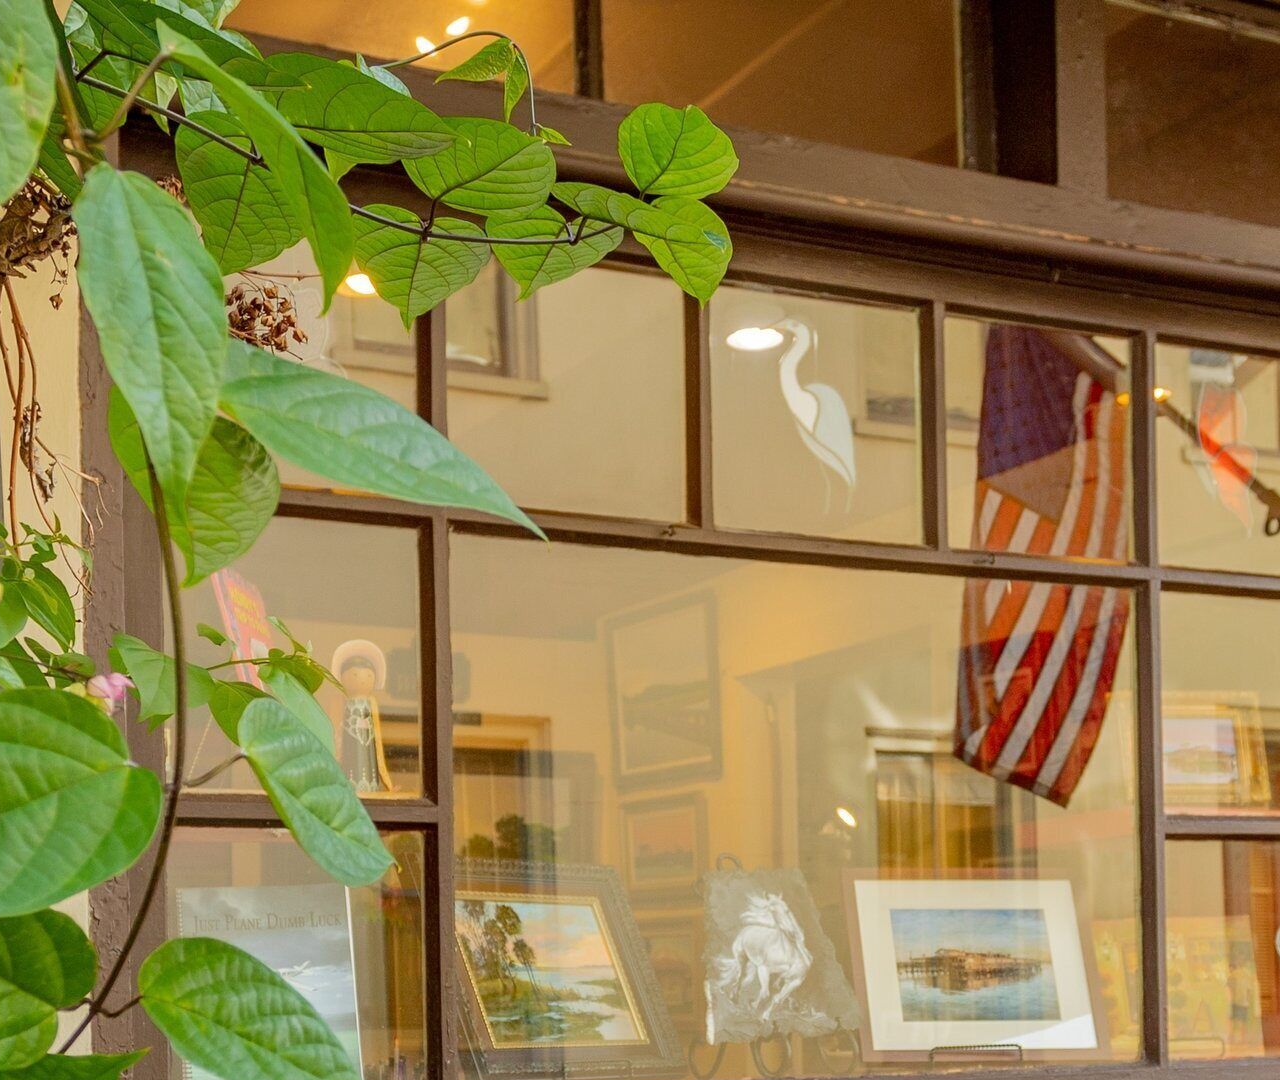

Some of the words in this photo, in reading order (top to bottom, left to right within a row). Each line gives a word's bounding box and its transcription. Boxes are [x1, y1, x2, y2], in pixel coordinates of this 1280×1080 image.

[193, 915, 219, 935] JUST
[224, 913, 262, 931] PLANE
[267, 912, 305, 930] DUMB
[309, 911, 343, 928] LUCK
